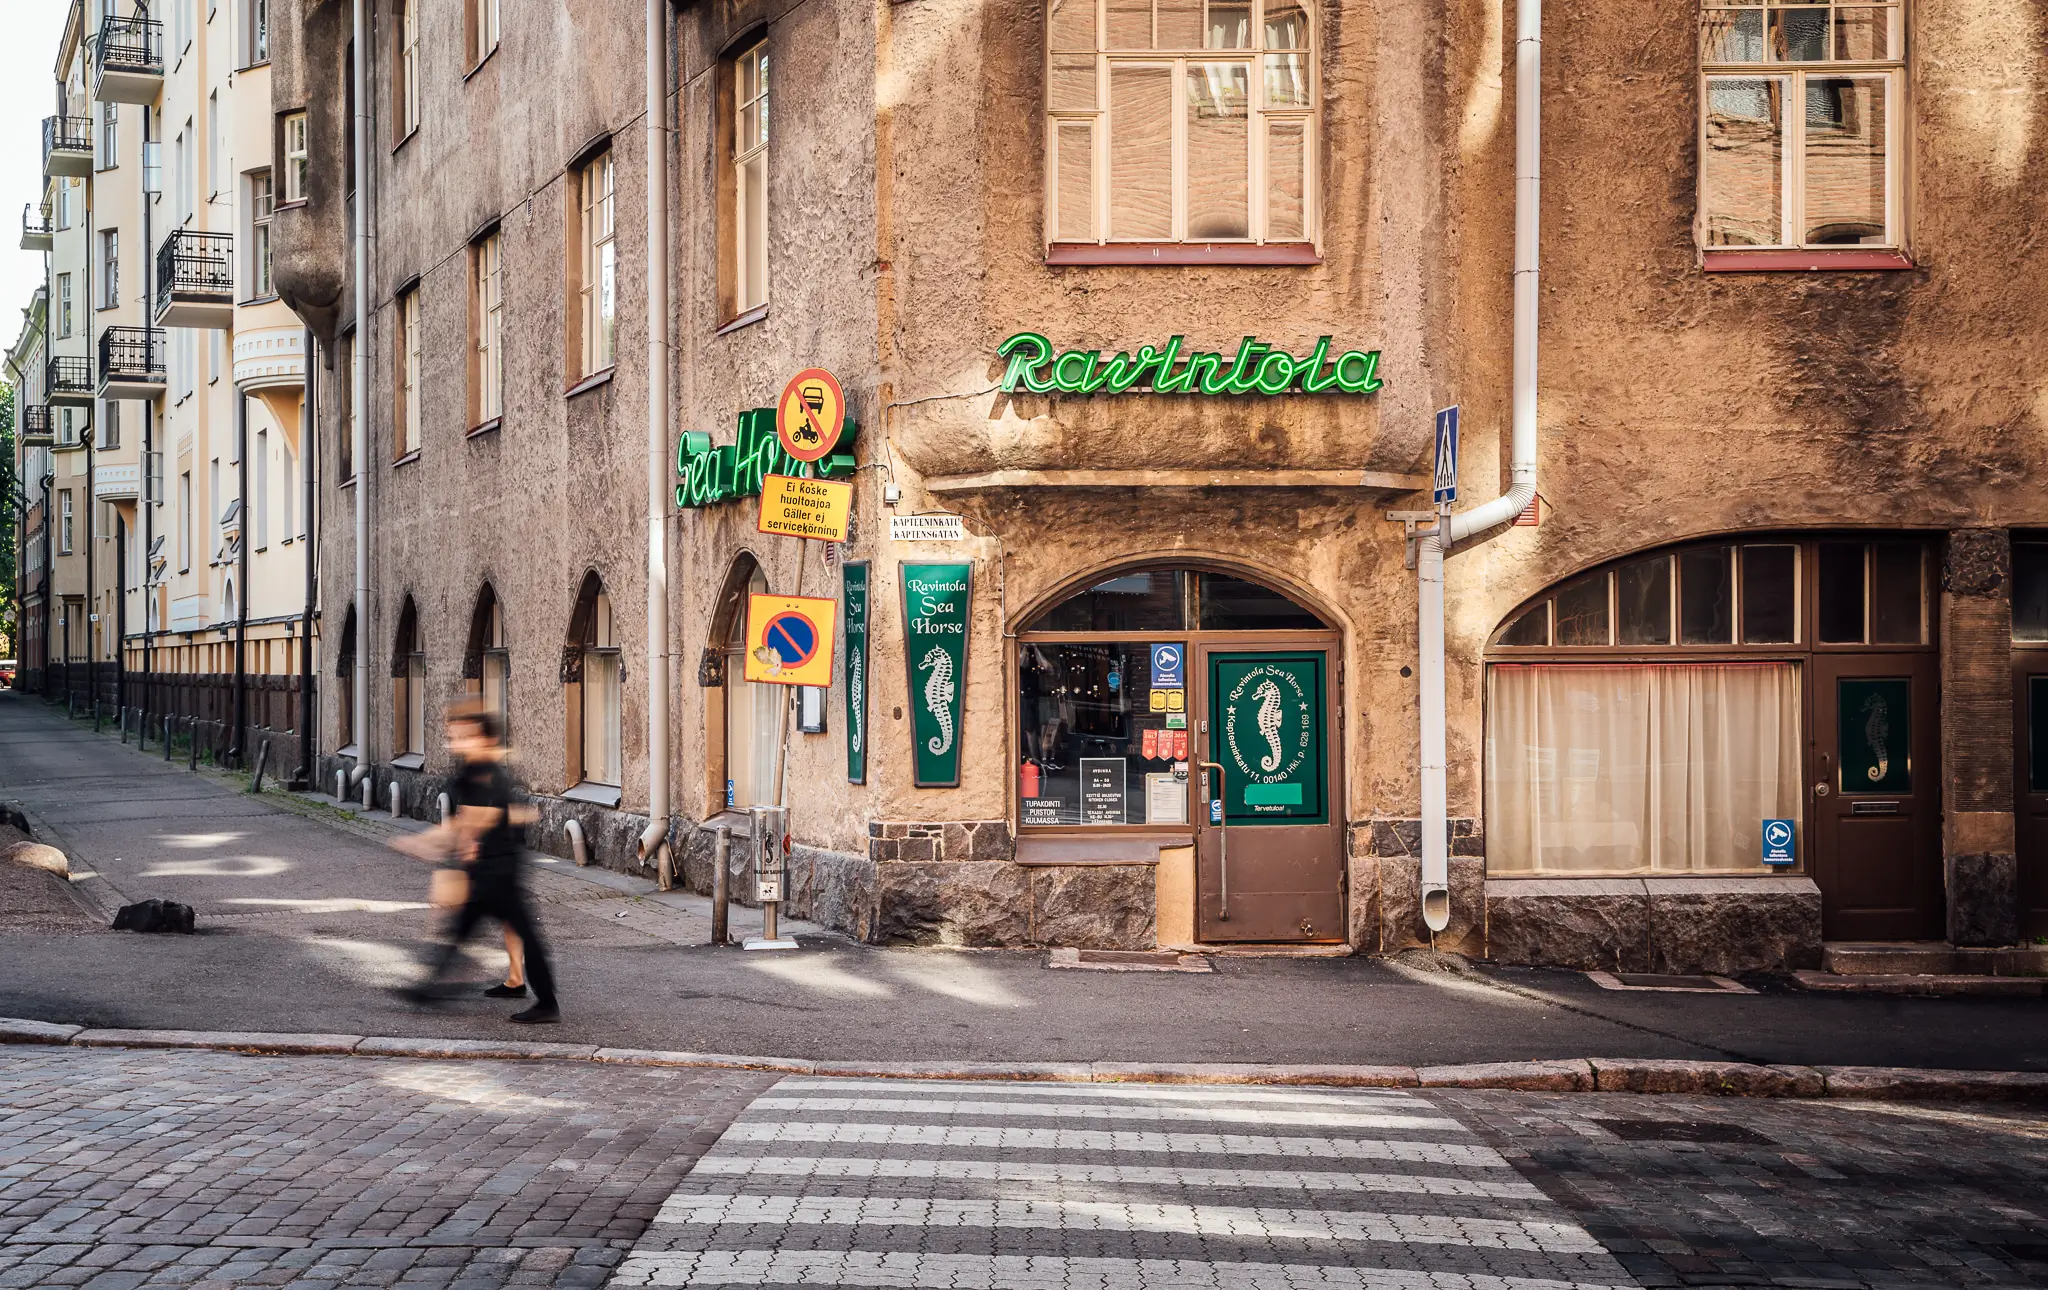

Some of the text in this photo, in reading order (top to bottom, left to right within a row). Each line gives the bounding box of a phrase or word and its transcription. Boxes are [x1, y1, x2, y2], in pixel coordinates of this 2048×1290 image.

[996, 332, 1384, 395] Ravintola
[676, 430, 723, 508] Sea
[786, 481, 828, 496] Ei koske
[780, 493, 831, 509] huoltoajoa
[783, 507, 825, 523] Gäller ej
[893, 517, 960, 527] KAPTEENINKATU
[767, 520, 838, 538] servicekörning
[894, 530, 959, 539] KAPTENSGATAN
[845, 580, 866, 595] Ravintola
[907, 579, 966, 595] Ravintola
[849, 596, 862, 616] Sea
[920, 596, 955, 616] Sea
[846, 618, 865, 634] Horse
[911, 617, 964, 634] Horse
[1229, 664, 1304, 701] Ravintola Sea Horse
[1301, 714, 1310, 729] 169
[1225, 715, 1250, 774] Kapteeninkatu
[1299, 731, 1310, 747] 628
[1250, 771, 1260, 783] 11,
[1263, 771, 1288, 784] 00140
[1025, 800, 1061, 808] TUPAKOINTI
[1029, 808, 1056, 816] PUISTON
